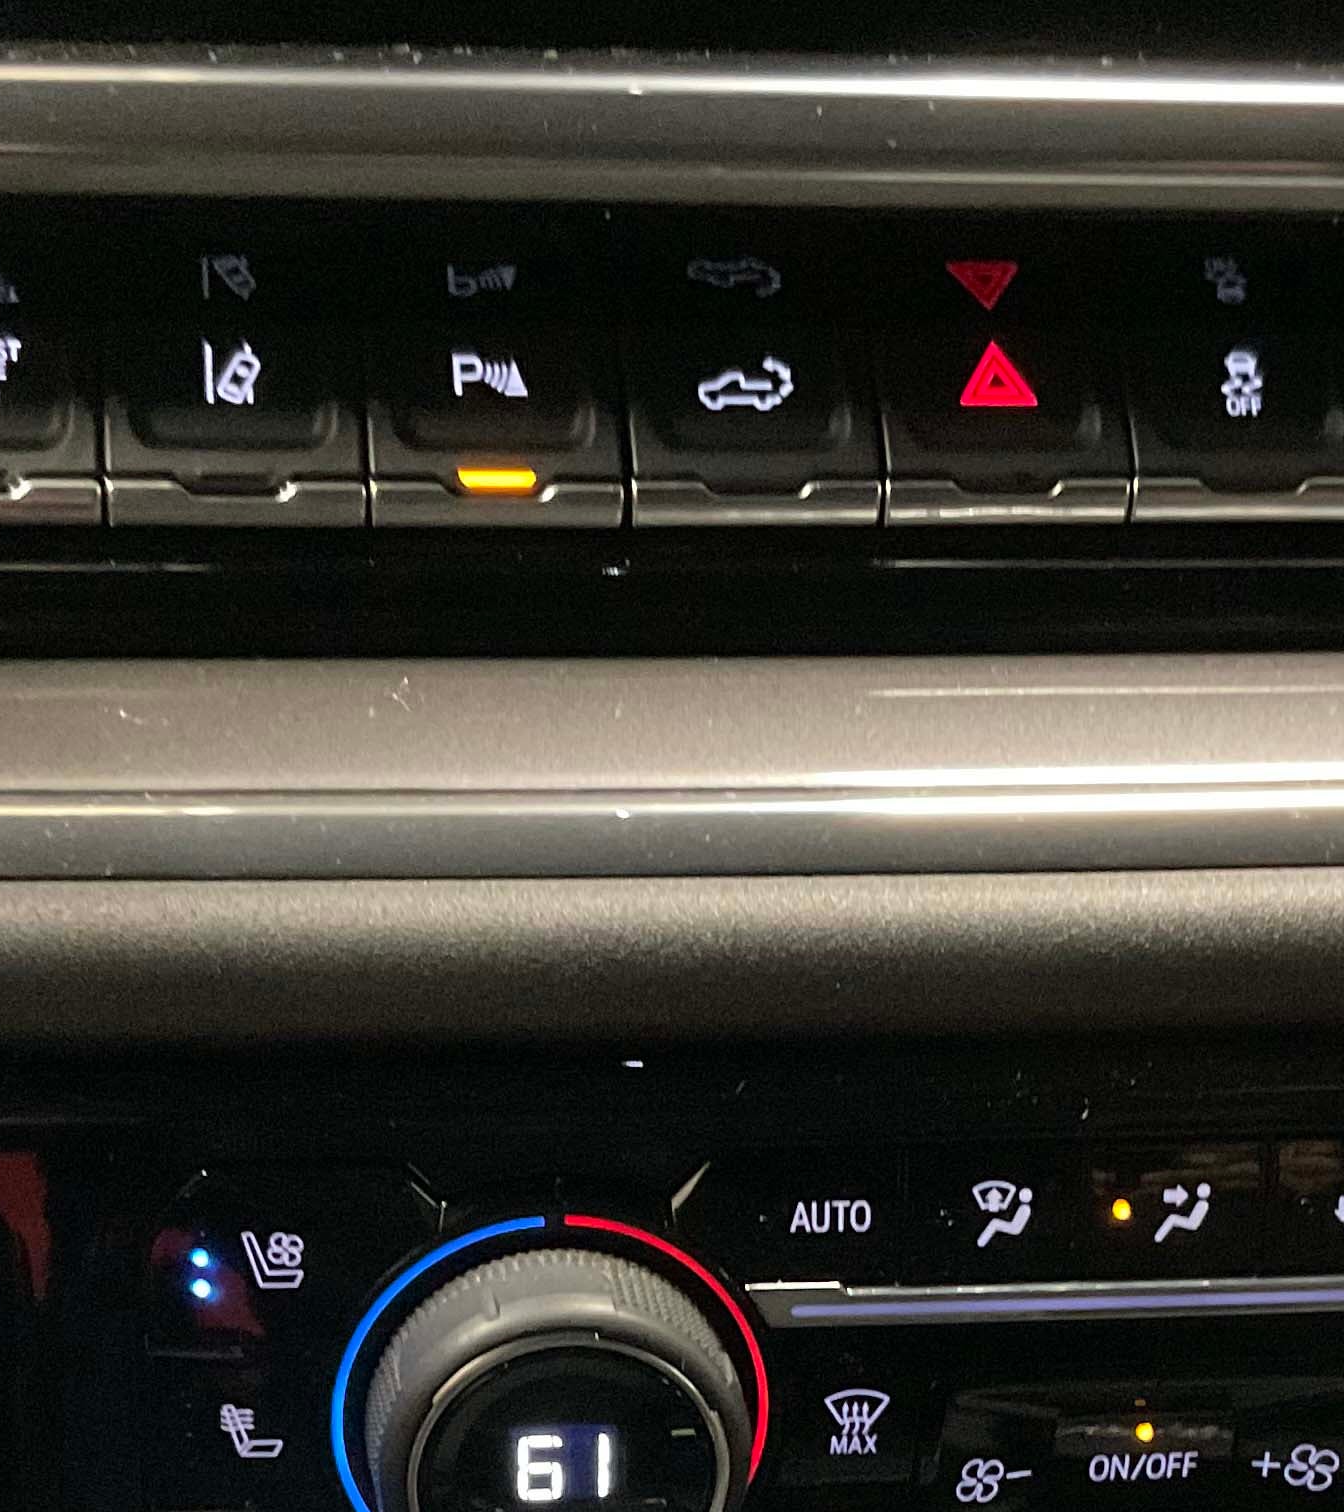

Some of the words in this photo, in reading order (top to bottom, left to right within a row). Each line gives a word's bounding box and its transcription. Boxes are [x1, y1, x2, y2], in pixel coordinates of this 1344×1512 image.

[1225, 396, 1262, 418] OFF
[788, 1199, 873, 1234] AUTO
[828, 1432, 879, 1456] MAX
[513, 1430, 613, 1504] 61
[1087, 1450, 1200, 1483] ON/OFF
